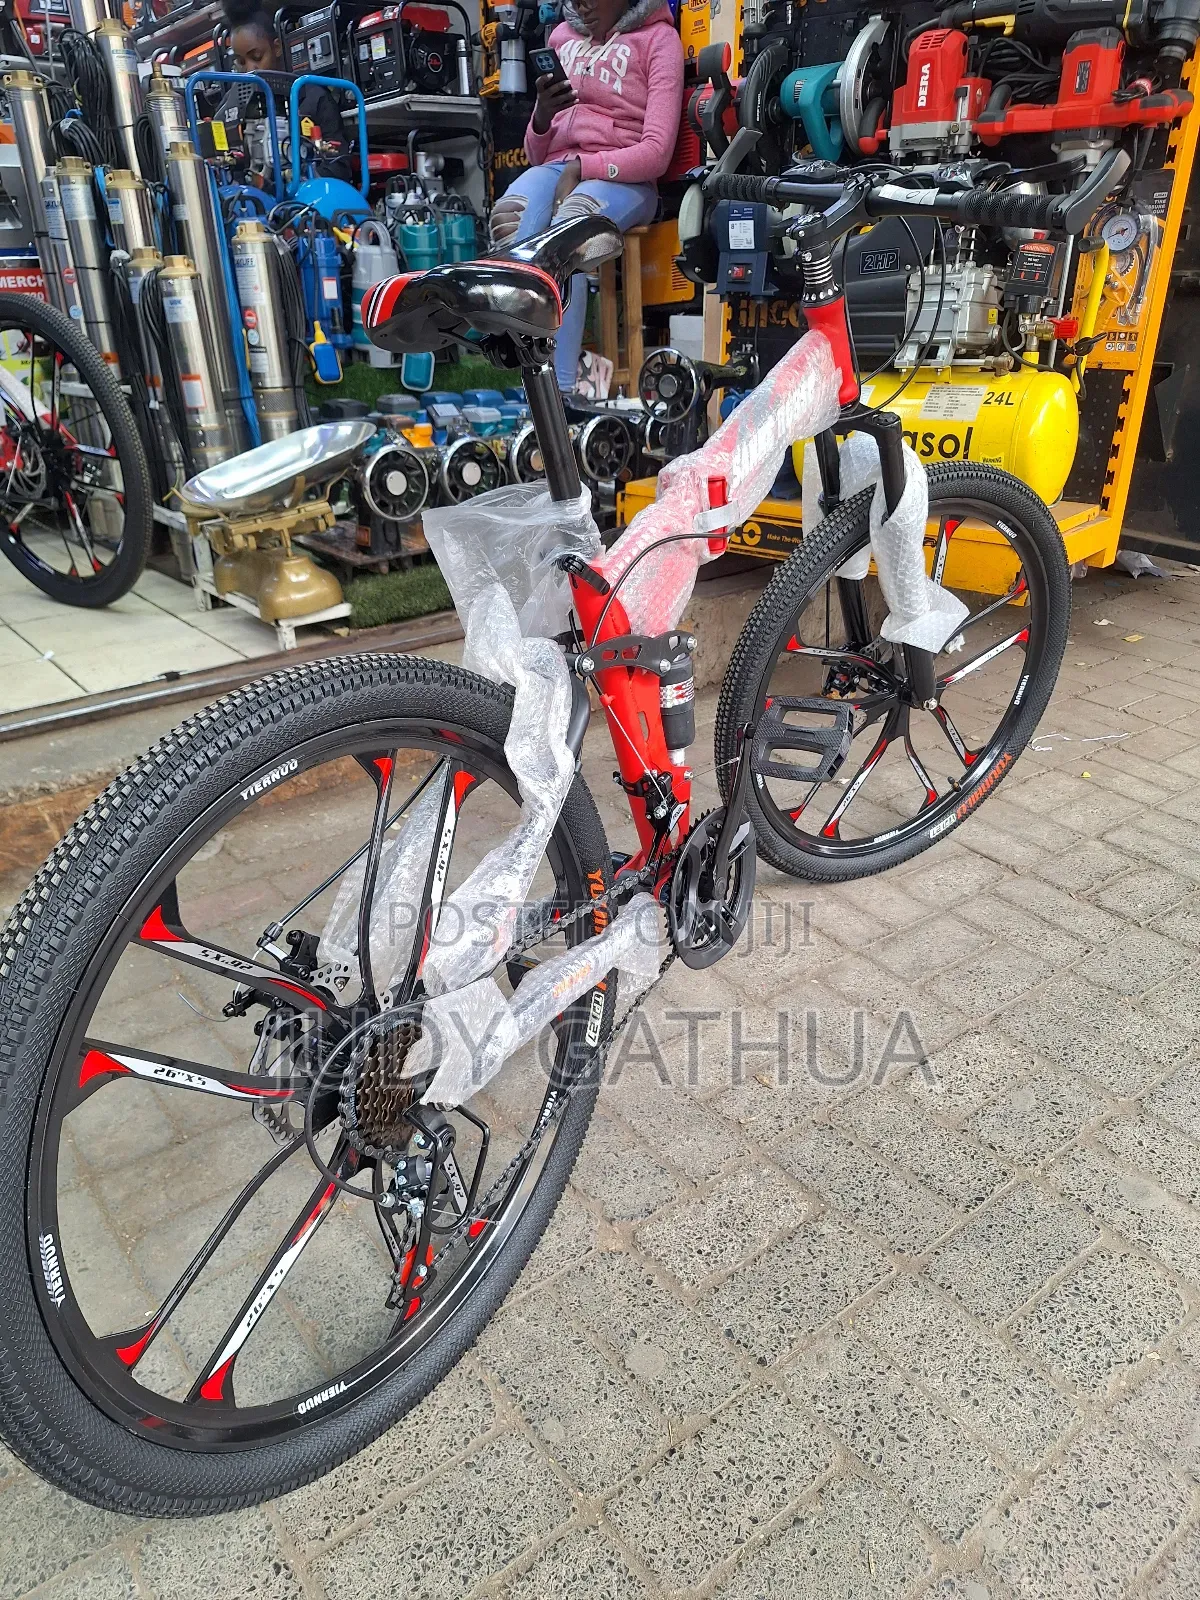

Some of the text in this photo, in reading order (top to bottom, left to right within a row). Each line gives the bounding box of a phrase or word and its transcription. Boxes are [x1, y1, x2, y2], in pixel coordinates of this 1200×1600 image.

[917, 63, 931, 107] DERA
[863, 252, 897, 271] 2HP
[983, 391, 1015, 407] 24L
[902, 426, 974, 460] asol
[239, 758, 299, 801] YIERNUO
[38, 1232, 66, 1308] YIERNUO
[297, 1380, 349, 1415] YIERNUO
